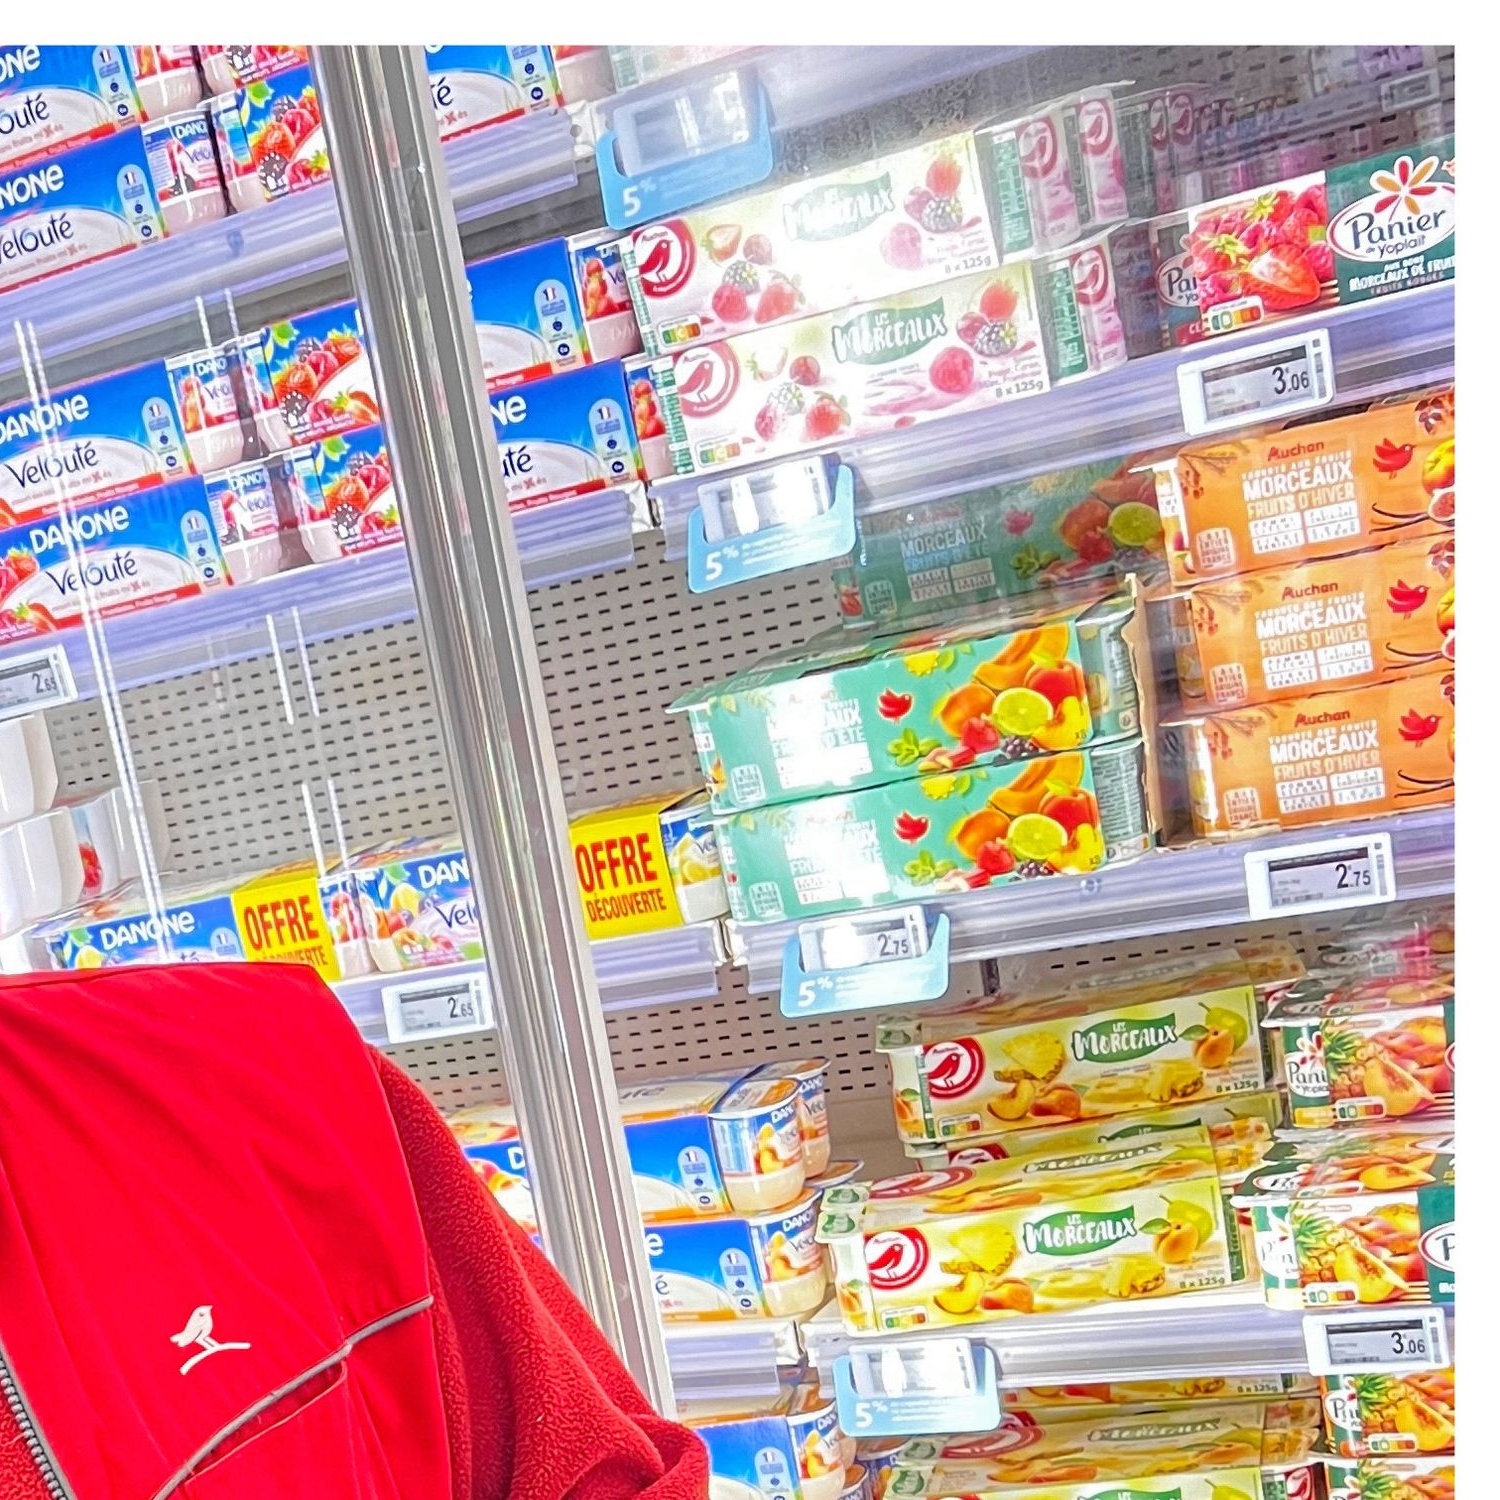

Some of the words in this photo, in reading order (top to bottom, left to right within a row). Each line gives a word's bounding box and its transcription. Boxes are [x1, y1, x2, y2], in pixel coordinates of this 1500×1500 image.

[1344, 209, 1446, 250] Panier
[1349, 268, 1409, 292] MORCEAUX
[4, 441, 99, 488] Velouté
[1267, 441, 1324, 461] Auchan
[1242, 459, 1354, 500] MORCEAUX
[1247, 495, 1296, 520] FRUITS
[1299, 482, 1356, 508] D'HIVER
[901, 524, 987, 558] MORCEAUX
[46, 551, 138, 595] Velouté
[1282, 581, 1338, 601] Auchan
[1256, 600, 1367, 640] MORCEAUX
[1260, 632, 1308, 656] FRUITS
[1312, 622, 1368, 647] D'HIVER
[1295, 710, 1350, 727] Auchan
[1269, 729, 1380, 764] MORCEAUX
[1274, 758, 1324, 781] FRUITS
[1325, 750, 1380, 772] D'HIVER
[574, 833, 658, 893] OFFRE
[243, 895, 319, 951] OFFRE
[586, 886, 668, 923] DÉCOUVERTE
[1073, 1020, 1178, 1061] MORCEAUX
[1023, 1215, 1137, 1254] MORCEAUX
